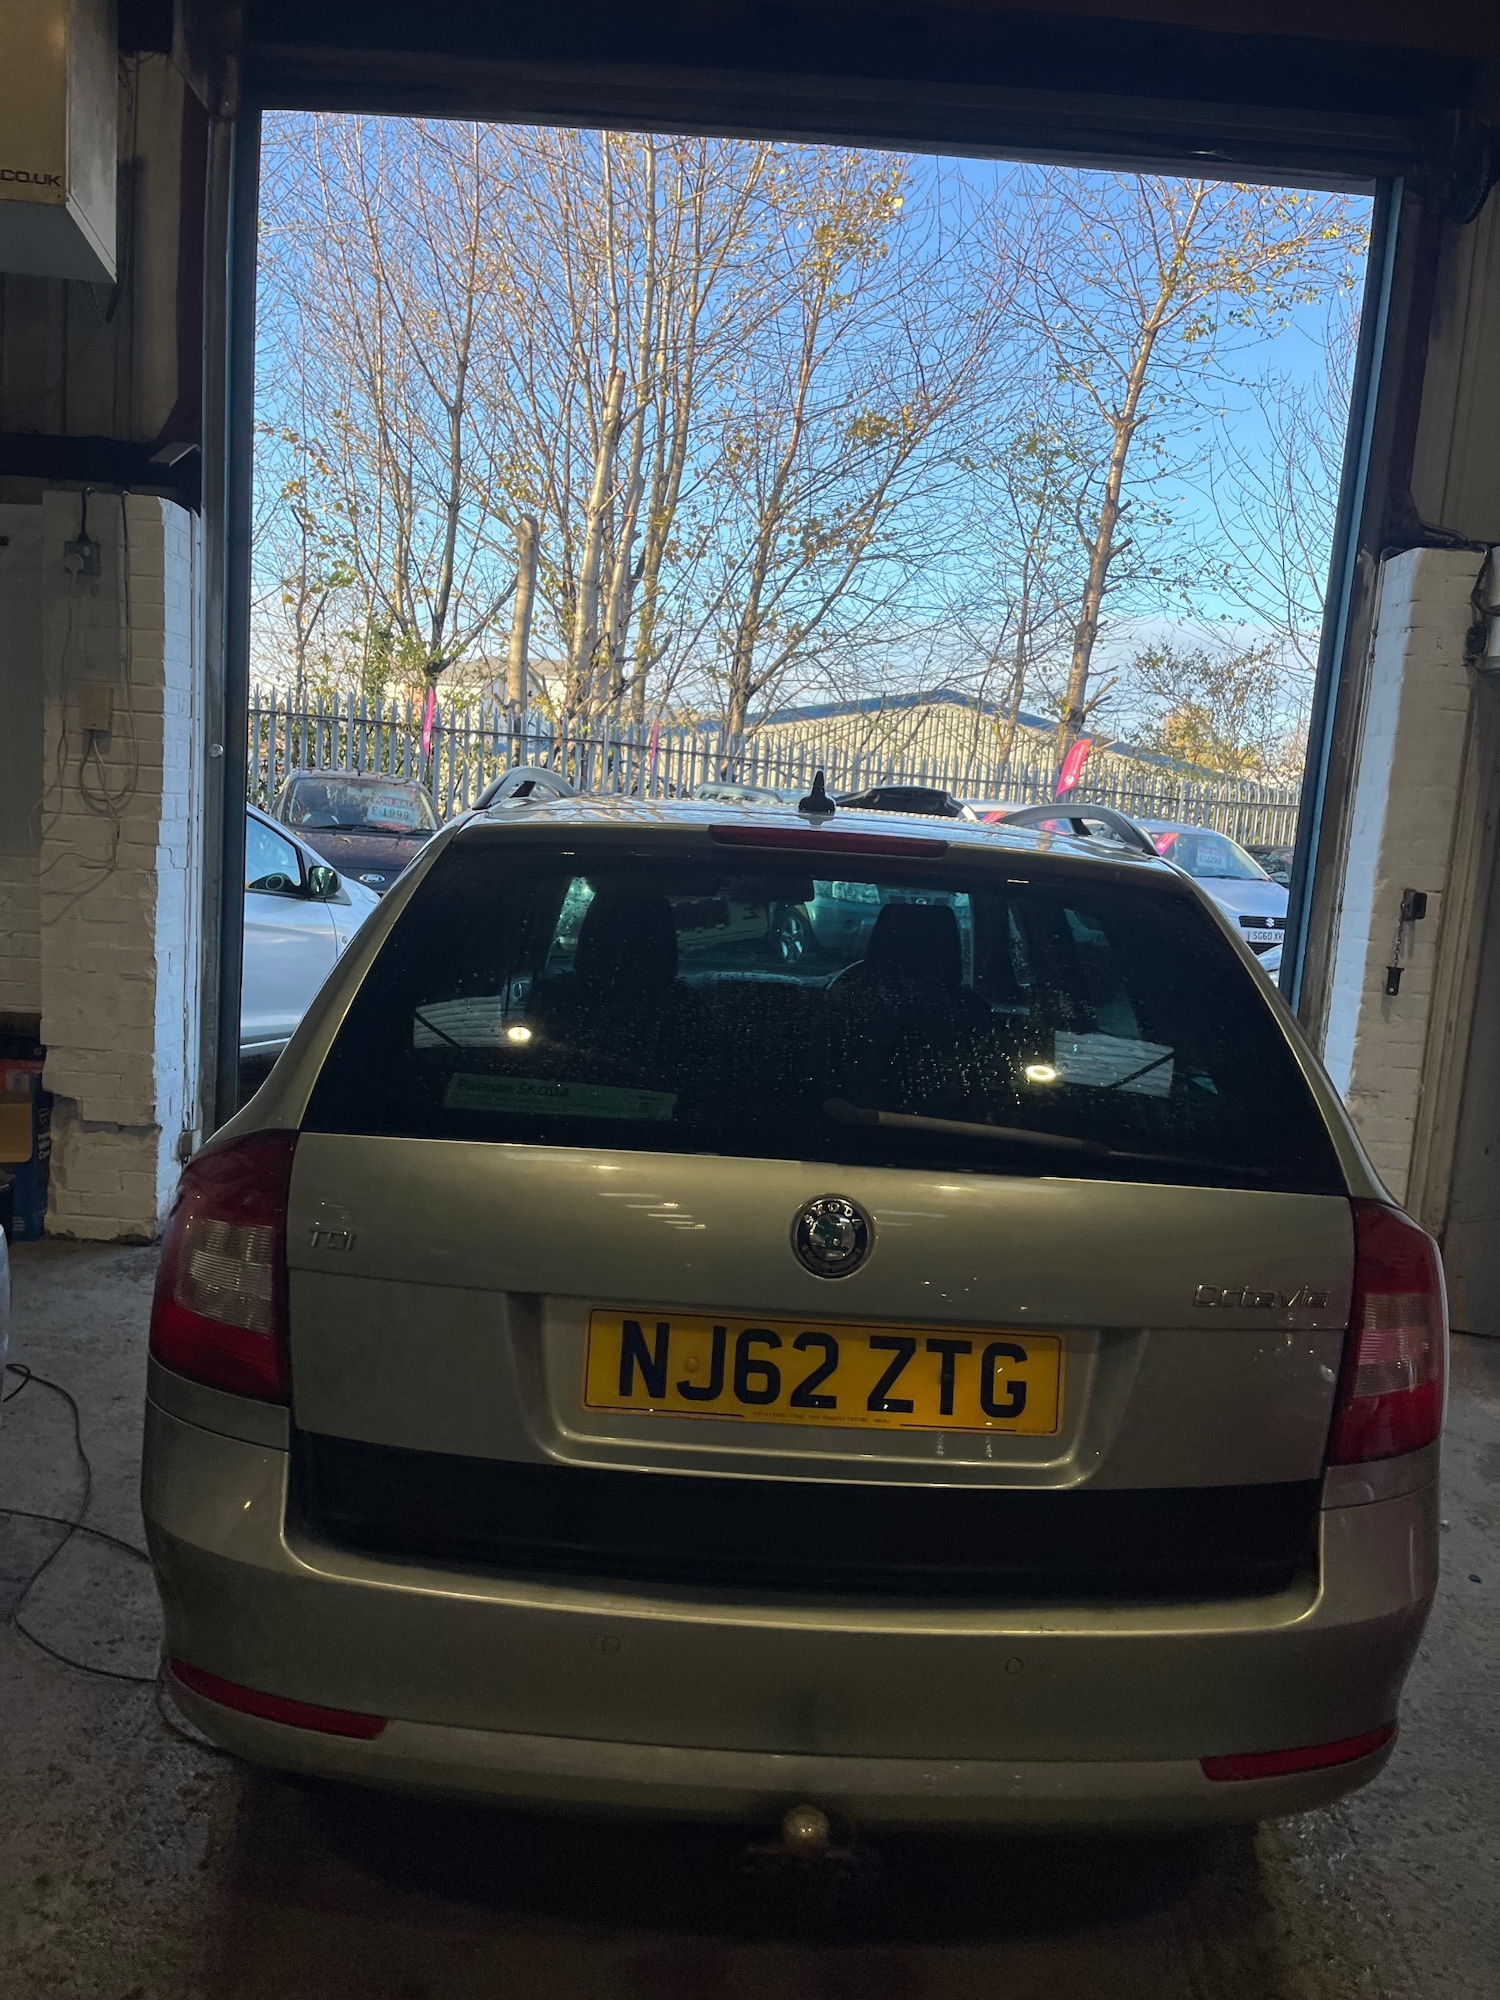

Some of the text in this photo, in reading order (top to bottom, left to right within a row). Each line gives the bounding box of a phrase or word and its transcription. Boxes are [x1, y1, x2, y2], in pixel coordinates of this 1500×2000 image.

[1253, 931, 1273, 941] SG60
[309, 1229, 357, 1252] TDI
[619, 1319, 1029, 1420] NJ62 ZTG
